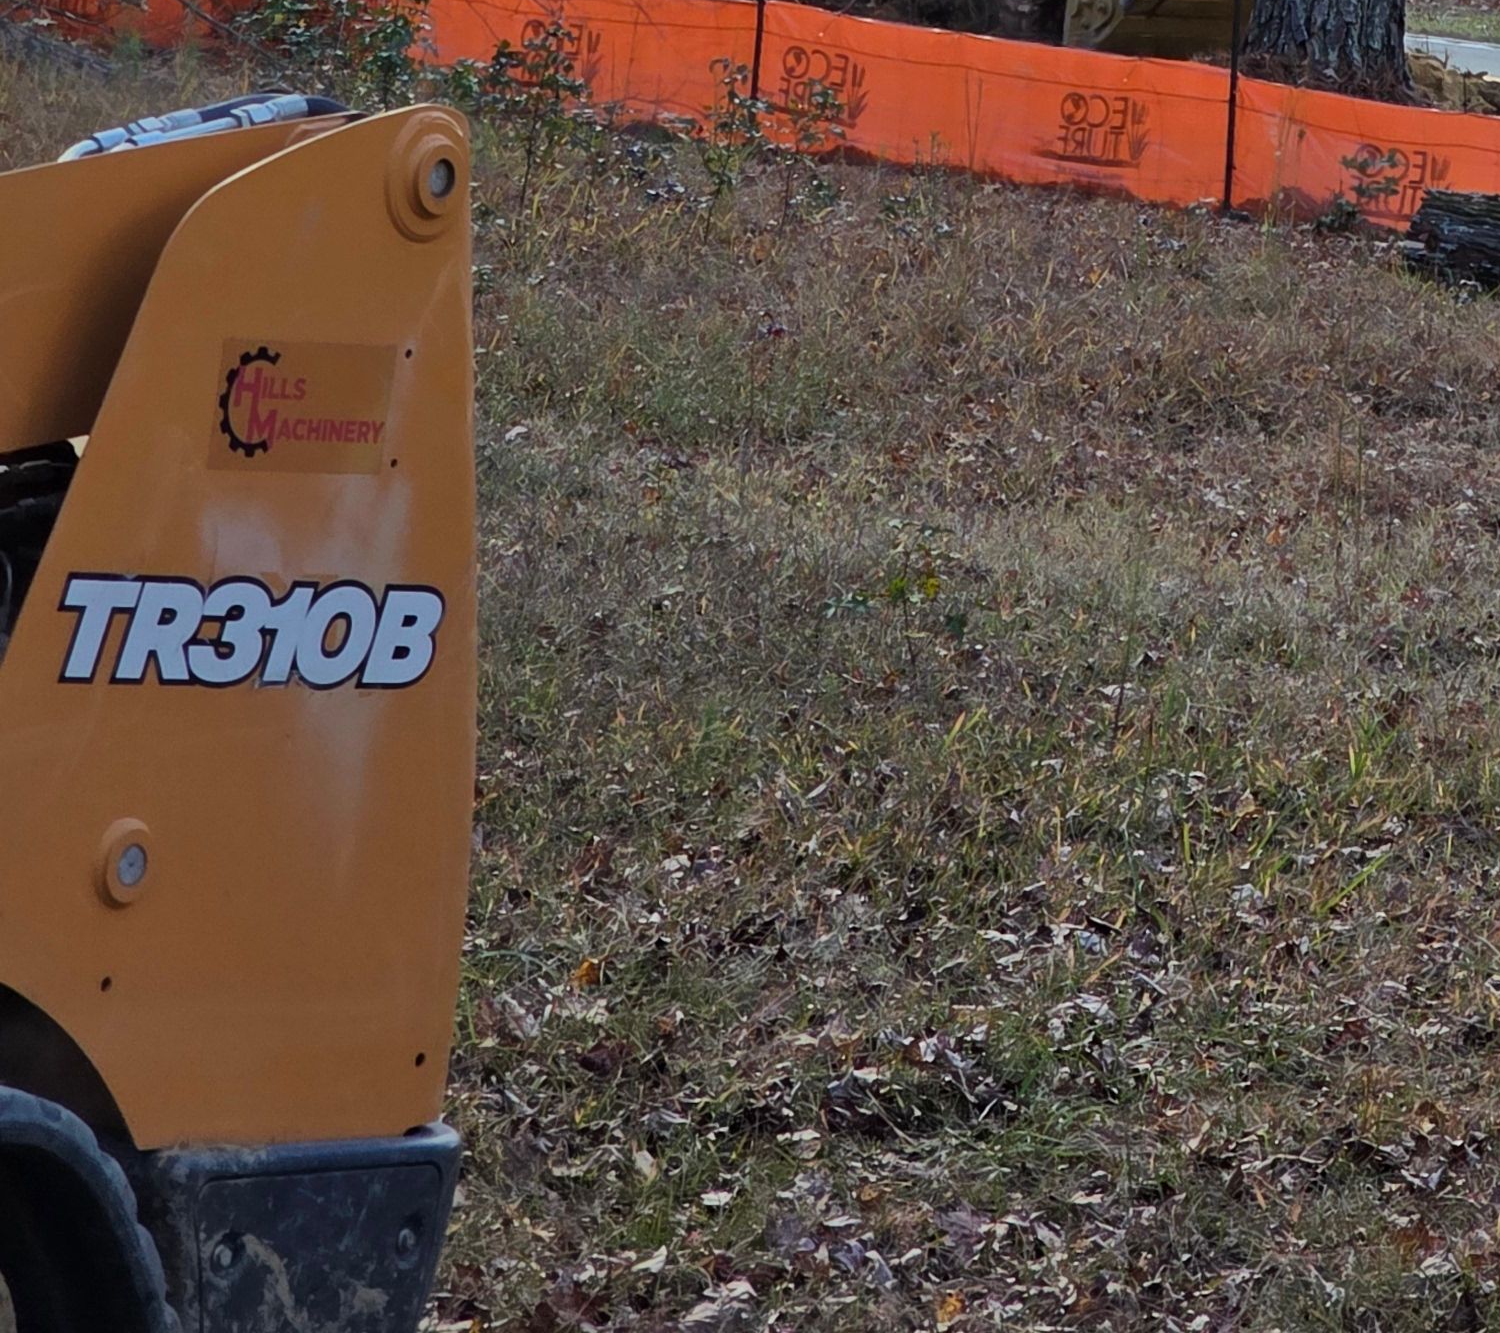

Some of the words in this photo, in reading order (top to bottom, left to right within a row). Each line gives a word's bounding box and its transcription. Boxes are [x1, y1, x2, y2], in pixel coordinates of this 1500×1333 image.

[233, 365, 307, 408] HILLS
[246, 407, 386, 449] MACHINERY
[57, 572, 446, 690] TR310B
